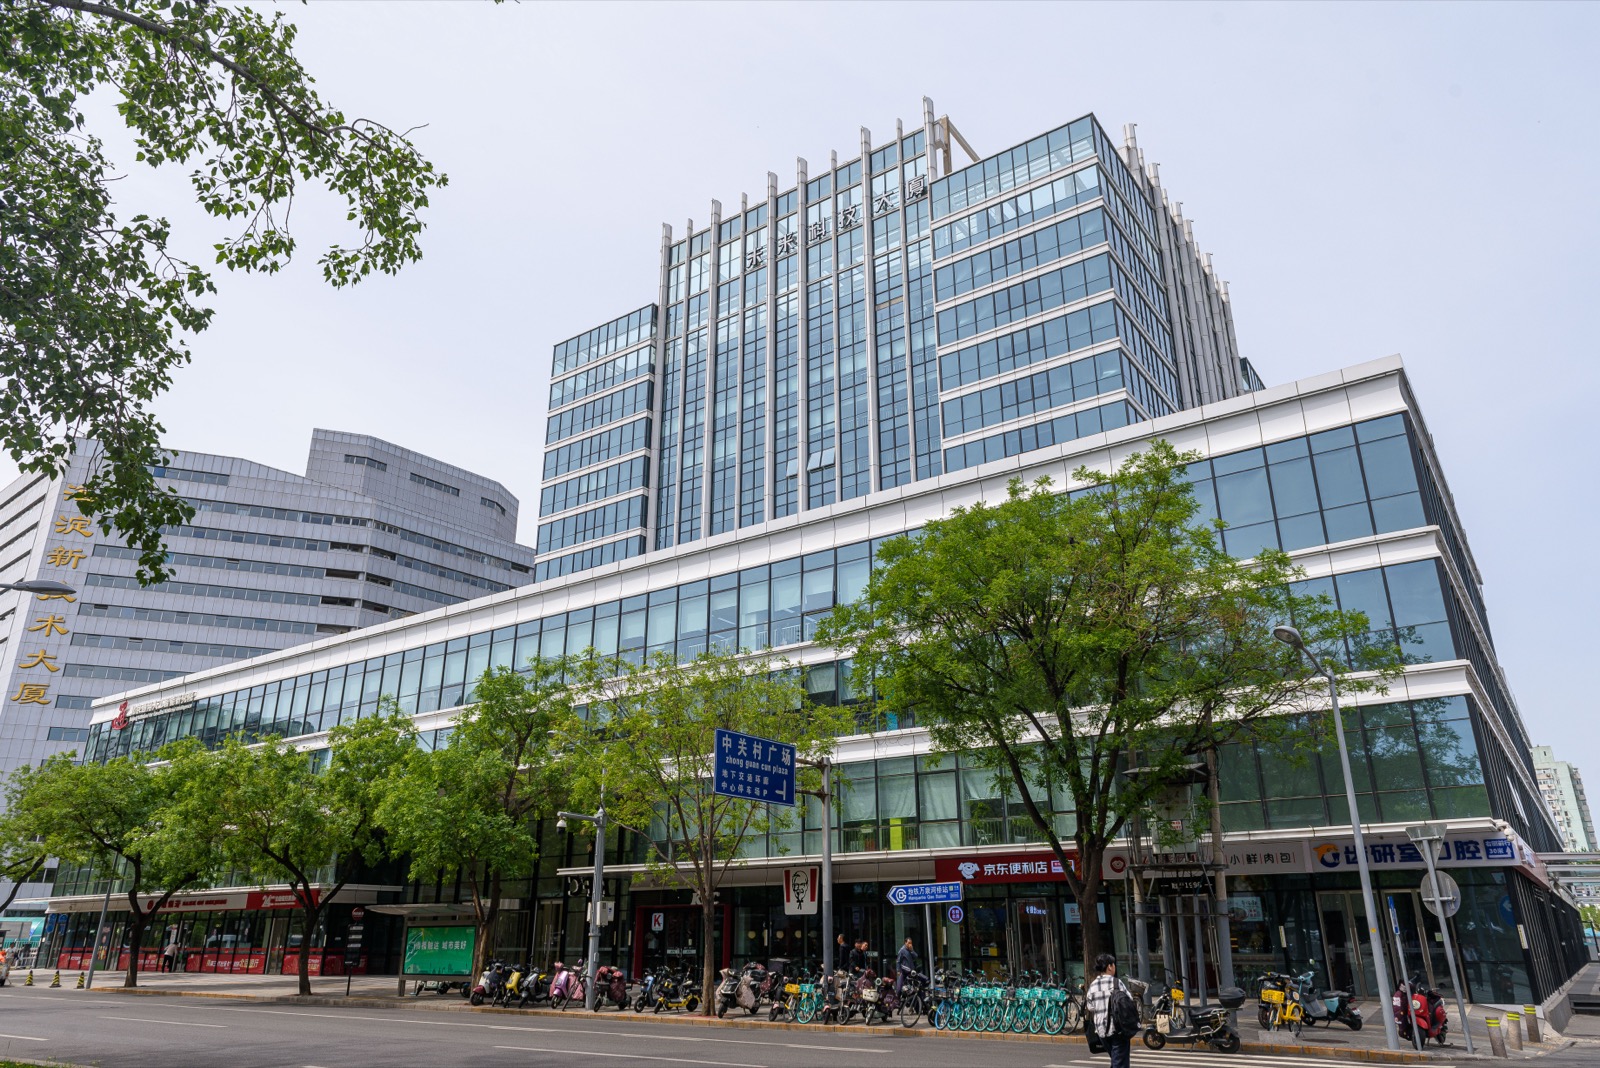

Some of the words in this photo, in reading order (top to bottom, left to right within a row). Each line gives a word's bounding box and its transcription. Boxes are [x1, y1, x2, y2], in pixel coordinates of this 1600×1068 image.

[745, 174, 926, 269] 未来科技大厦
[10, 483, 98, 705] 海淀新术大厦
[722, 734, 791, 765] 中关村广场
[726, 755, 744, 767] zhong
[745, 760, 760, 769] guan
[761, 763, 772, 771] cun
[773, 764, 788, 774] plaza
[722, 769, 769, 785] 地下交通环廊
[1230, 852, 1291, 865] 小鲜肉包
[983, 861, 1048, 876] 京东便利店
[690, 891, 720, 904] KC
[653, 914, 662, 927] K
